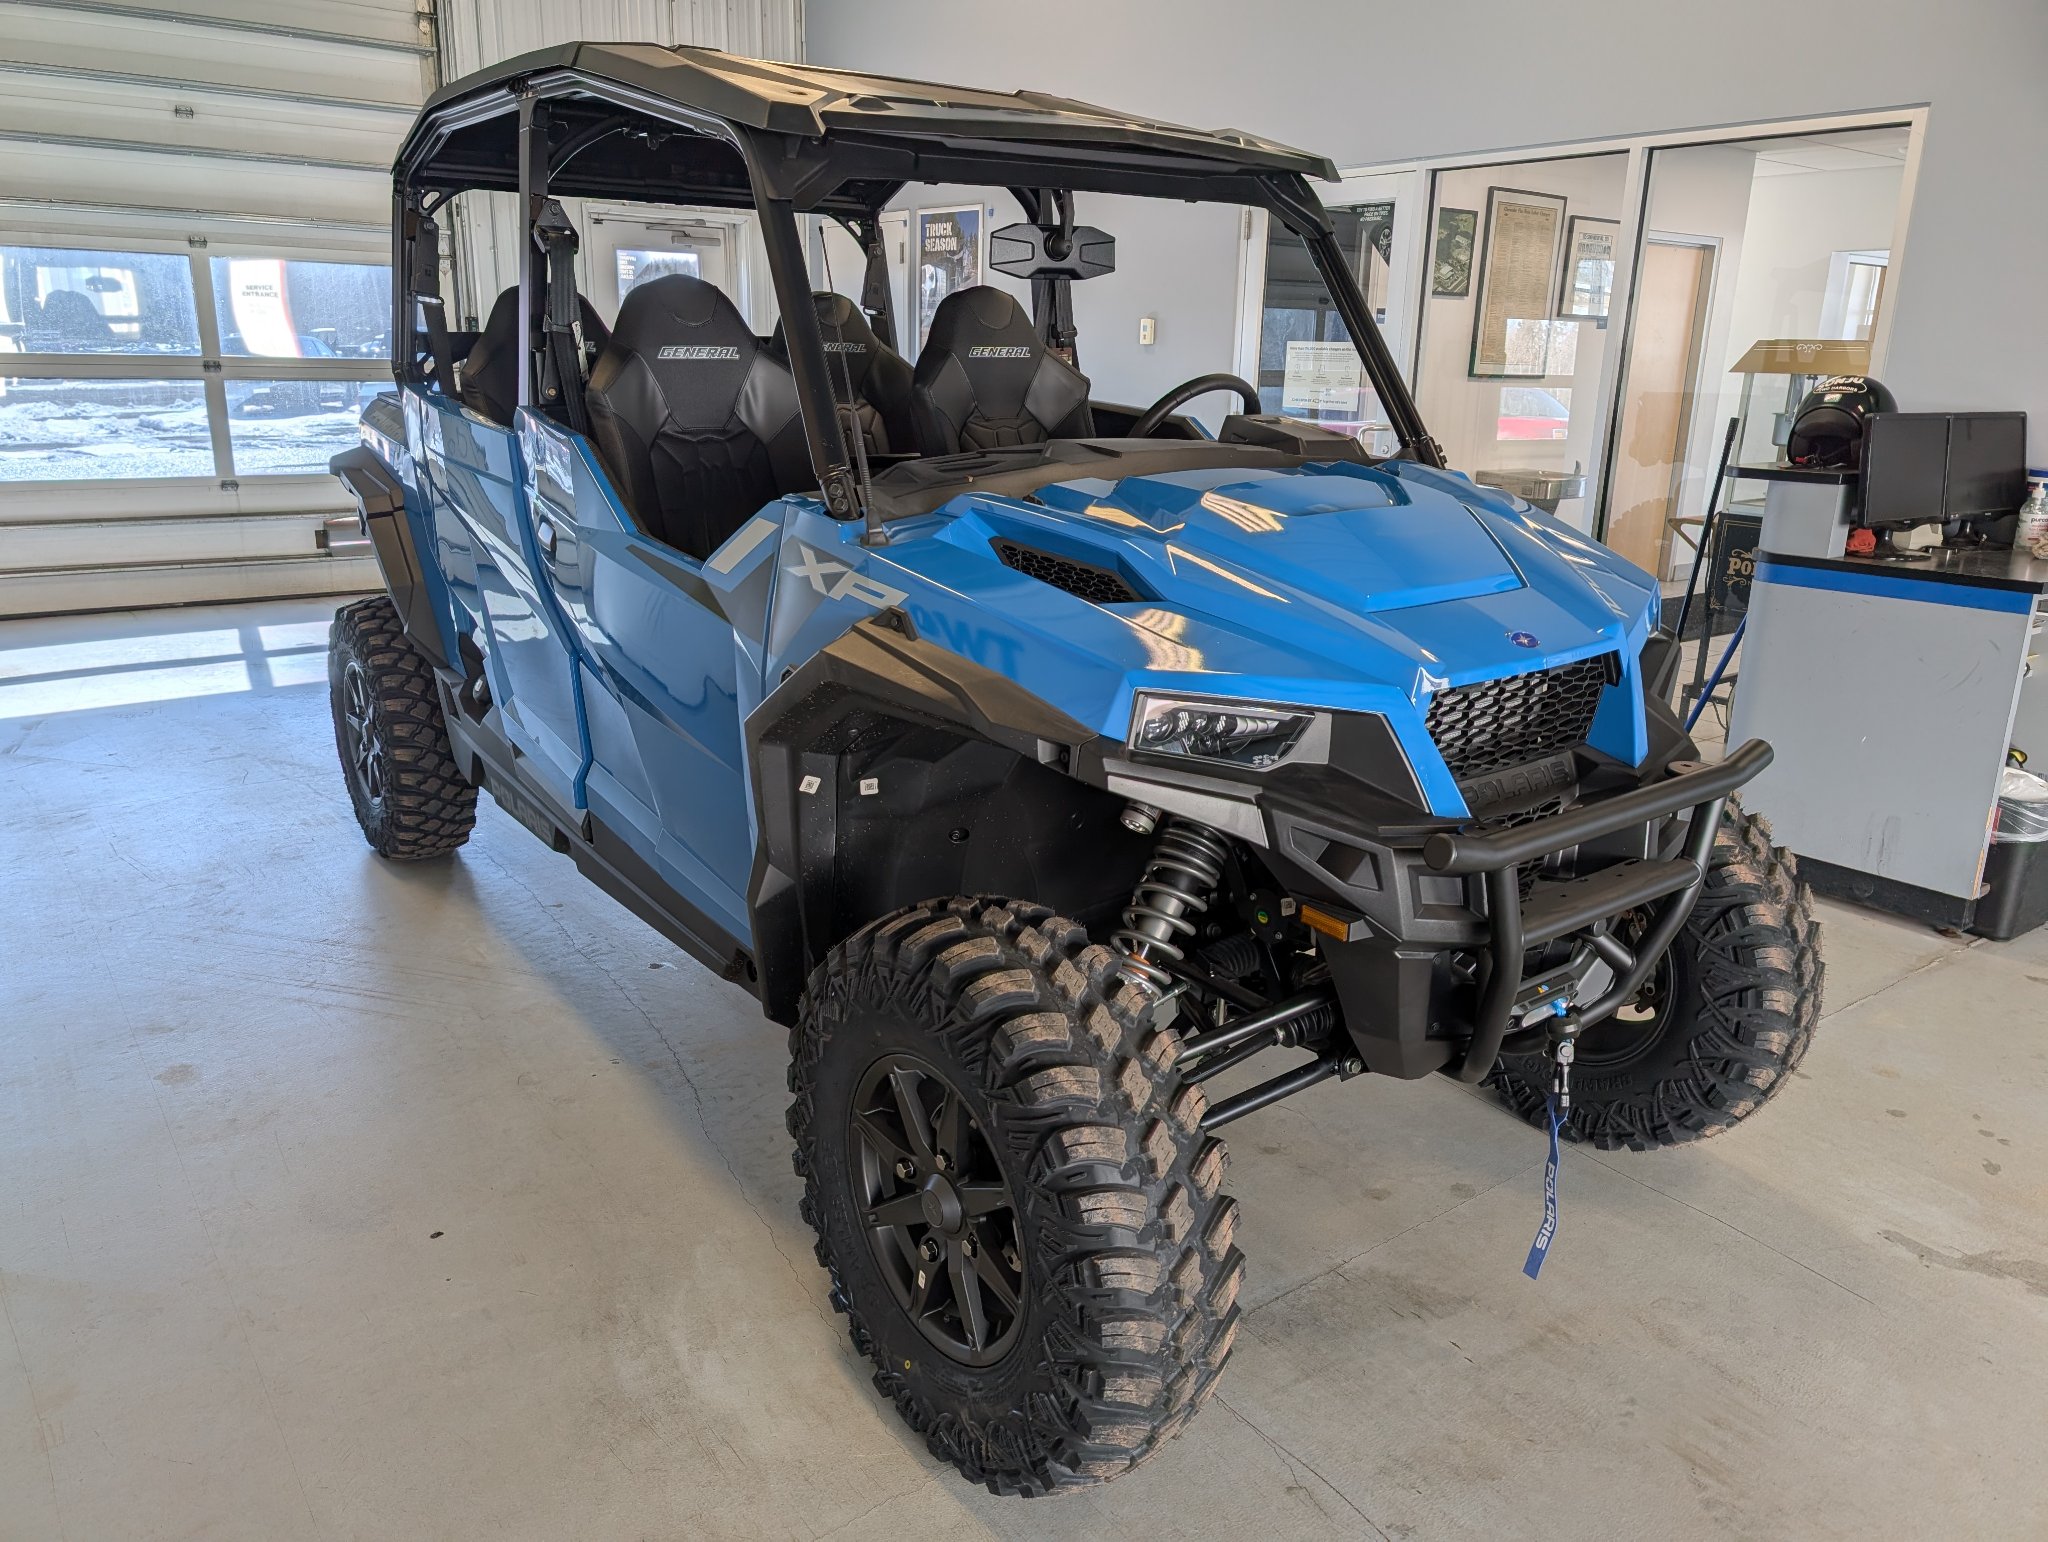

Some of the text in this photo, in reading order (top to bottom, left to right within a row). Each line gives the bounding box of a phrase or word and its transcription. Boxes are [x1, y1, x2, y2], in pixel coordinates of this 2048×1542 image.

[925, 222, 953, 237] TRUCK
[925, 237, 958, 252] SEASON
[658, 346, 740, 359] GENERAL
[968, 346, 1031, 358] GENERAL
[783, 543, 910, 611] XP
[1463, 760, 1570, 804] POLARIS
[490, 776, 552, 843] POLARIS
[1535, 1161, 1556, 1251] POLARIS
